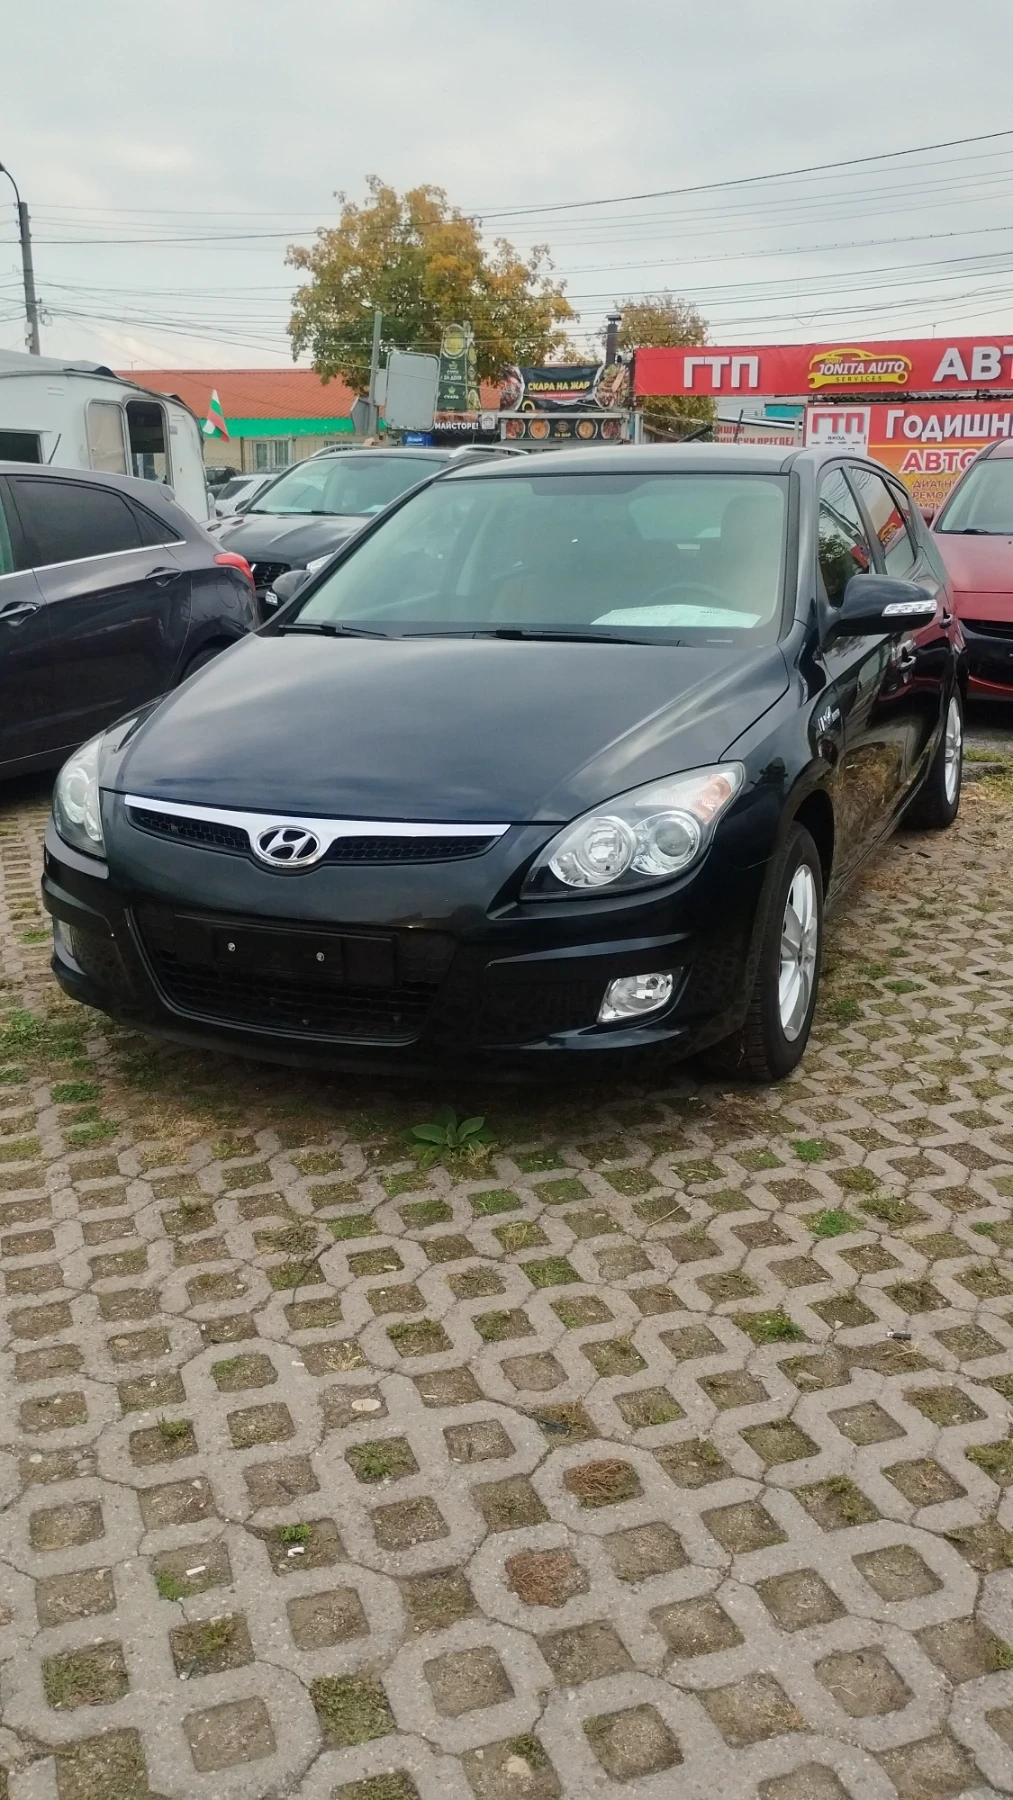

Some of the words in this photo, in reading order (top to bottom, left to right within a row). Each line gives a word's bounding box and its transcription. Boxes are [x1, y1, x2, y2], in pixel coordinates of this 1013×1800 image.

[683, 355, 759, 388] ГТП
[818, 362, 865, 375] JONITA
[868, 360, 905, 374] AUTO
[528, 382, 555, 391] СКАРА
[556, 382, 569, 391] НА
[570, 381, 590, 390] ЖАР
[435, 421, 479, 430] МАЙСТОРЕ!
[812, 412, 865, 434] ГТП
[885, 409, 1013, 443] Годишн
[913, 480, 955, 488] ДИАГН
